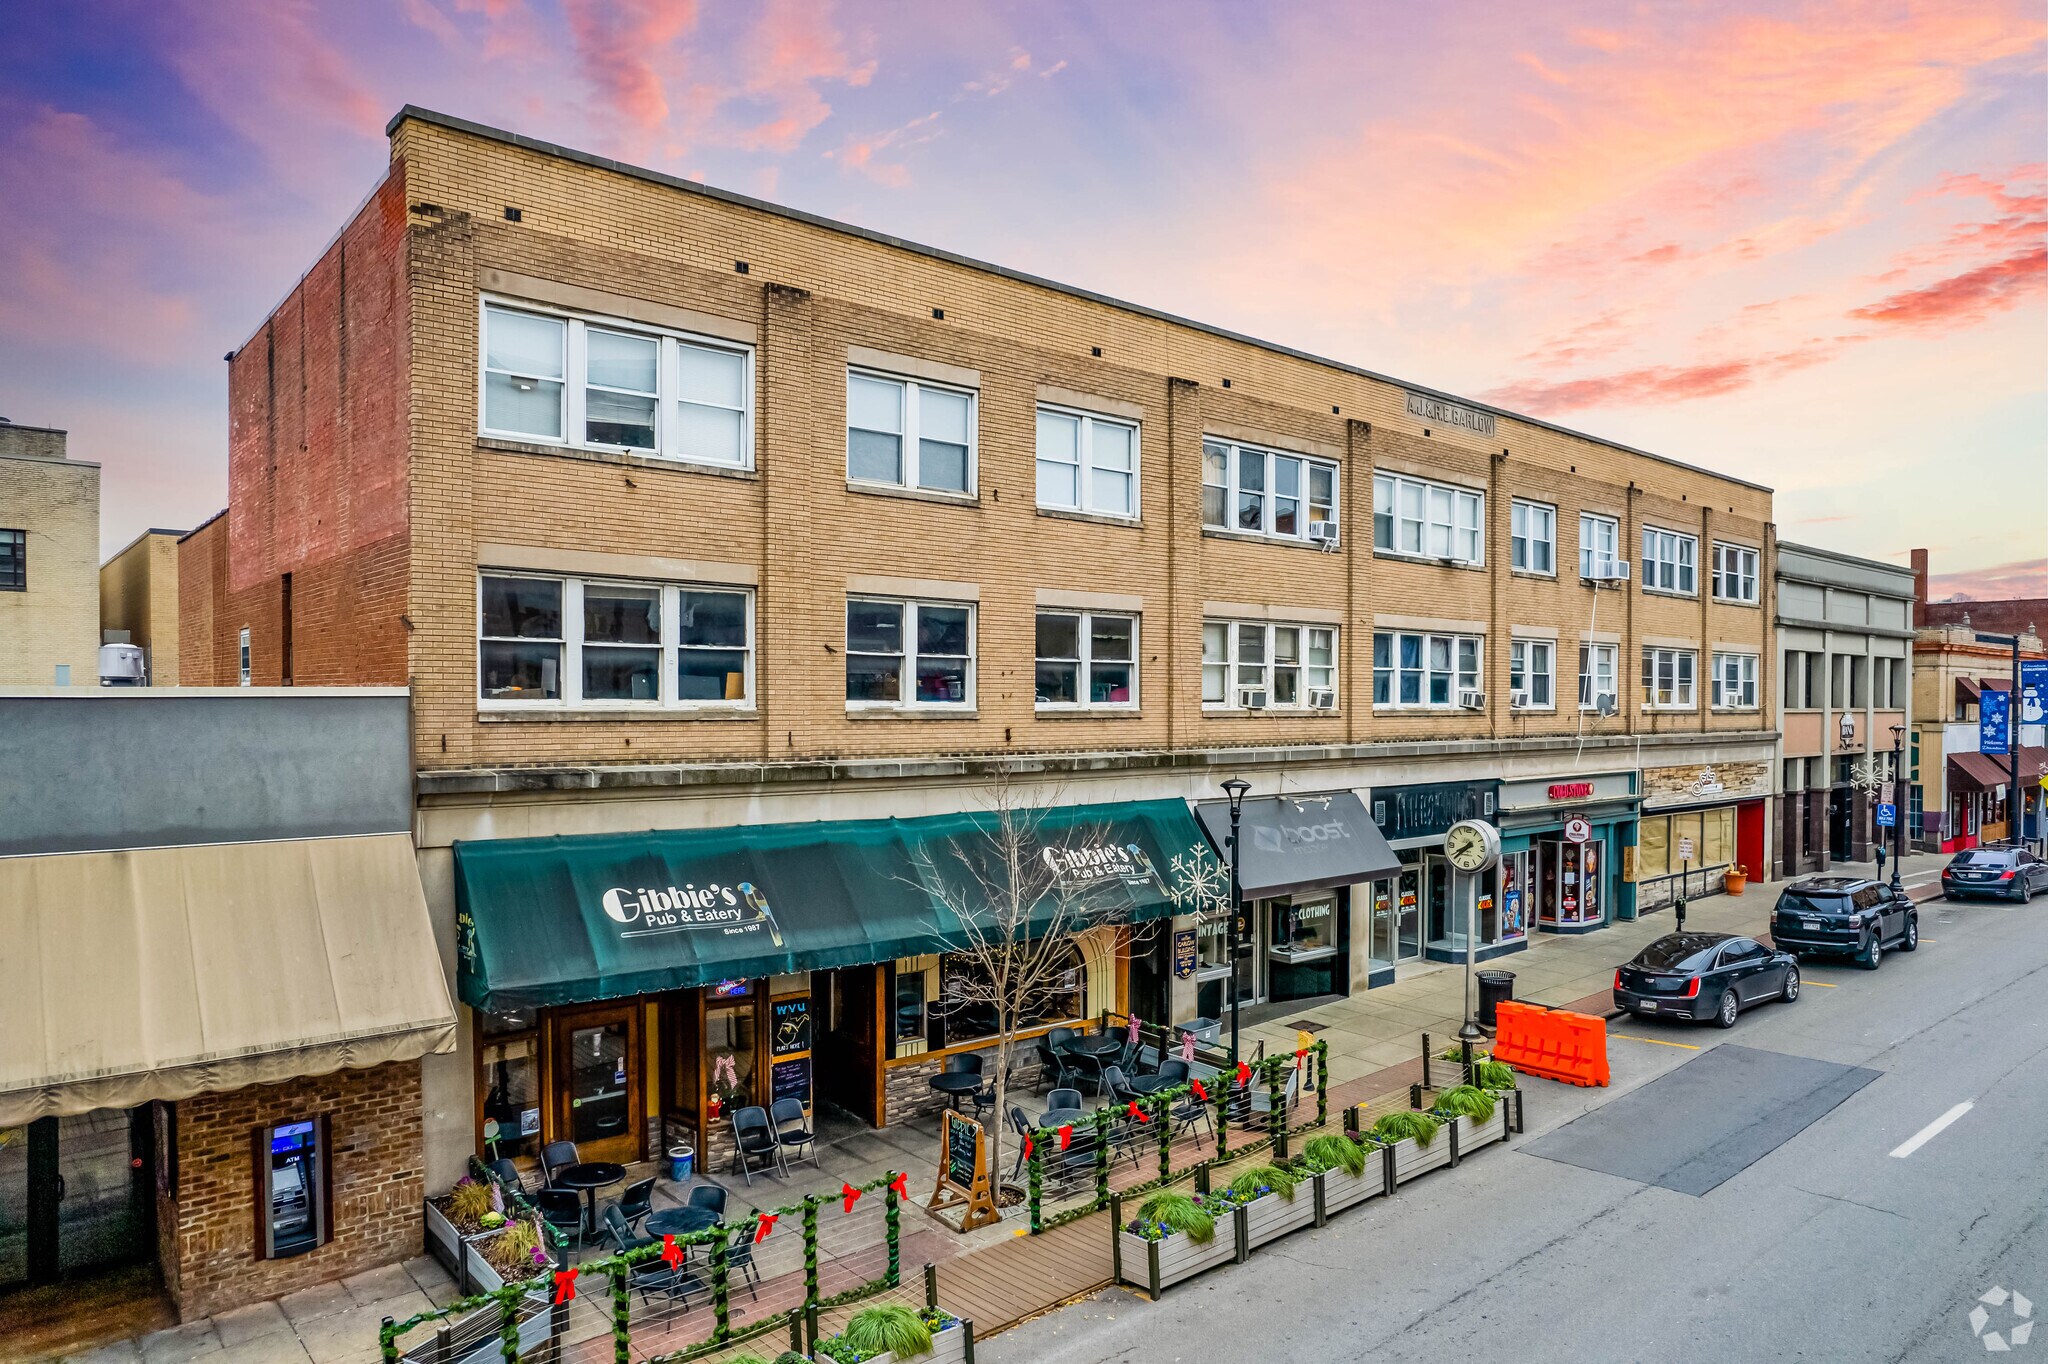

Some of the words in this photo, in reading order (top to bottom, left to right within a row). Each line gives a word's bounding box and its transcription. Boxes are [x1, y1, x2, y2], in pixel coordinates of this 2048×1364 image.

[1042, 843, 1130, 876] Gibbie's
[1094, 864, 1105, 877] &
[1104, 862, 1135, 875] Eatery
[602, 883, 737, 923] Gibbie's
[645, 914, 677, 927] Pub
[680, 909, 693, 922] &
[694, 908, 742, 922] Eatery
[1298, 904, 1330, 920] CLOTHING
[724, 927, 743, 935] Since
[744, 924, 760, 932] 1987
[1196, 921, 1229, 938] INTAGE
[776, 1003, 806, 1016] WVU
